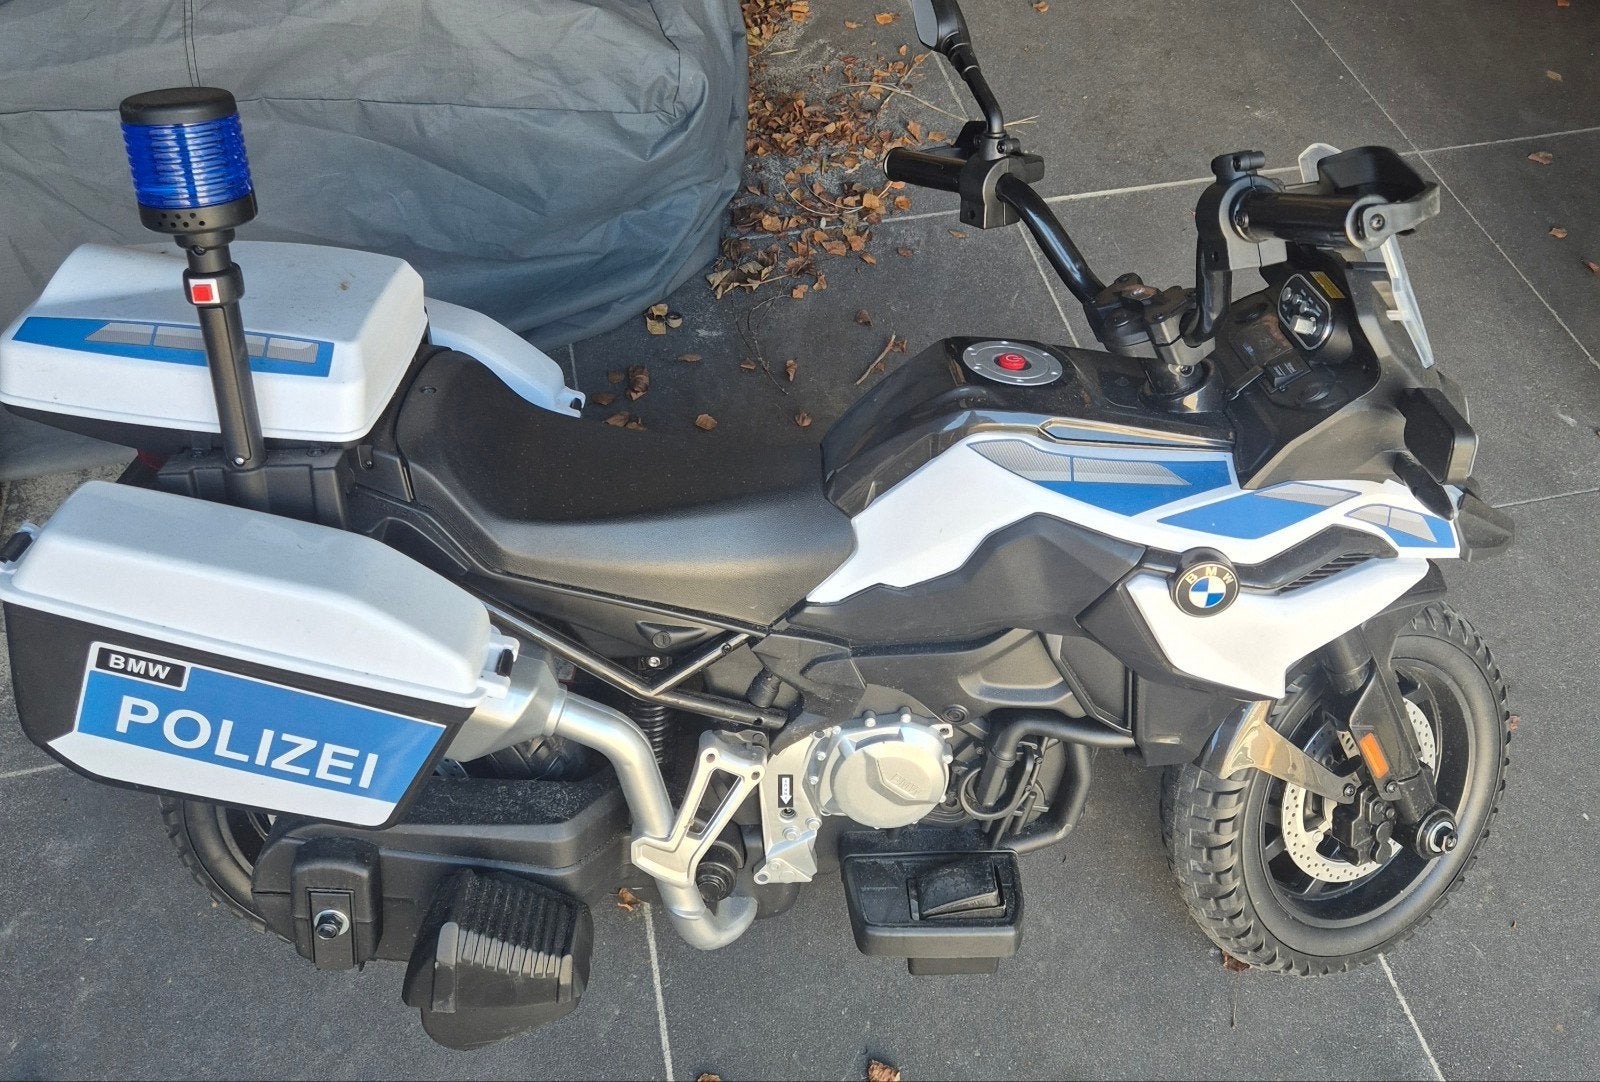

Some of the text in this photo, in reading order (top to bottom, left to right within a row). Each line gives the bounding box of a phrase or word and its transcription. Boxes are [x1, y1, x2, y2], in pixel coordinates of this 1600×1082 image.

[1184, 566, 1234, 584] BMW
[108, 653, 171, 680] BMW
[115, 695, 379, 789] POLIZEI
